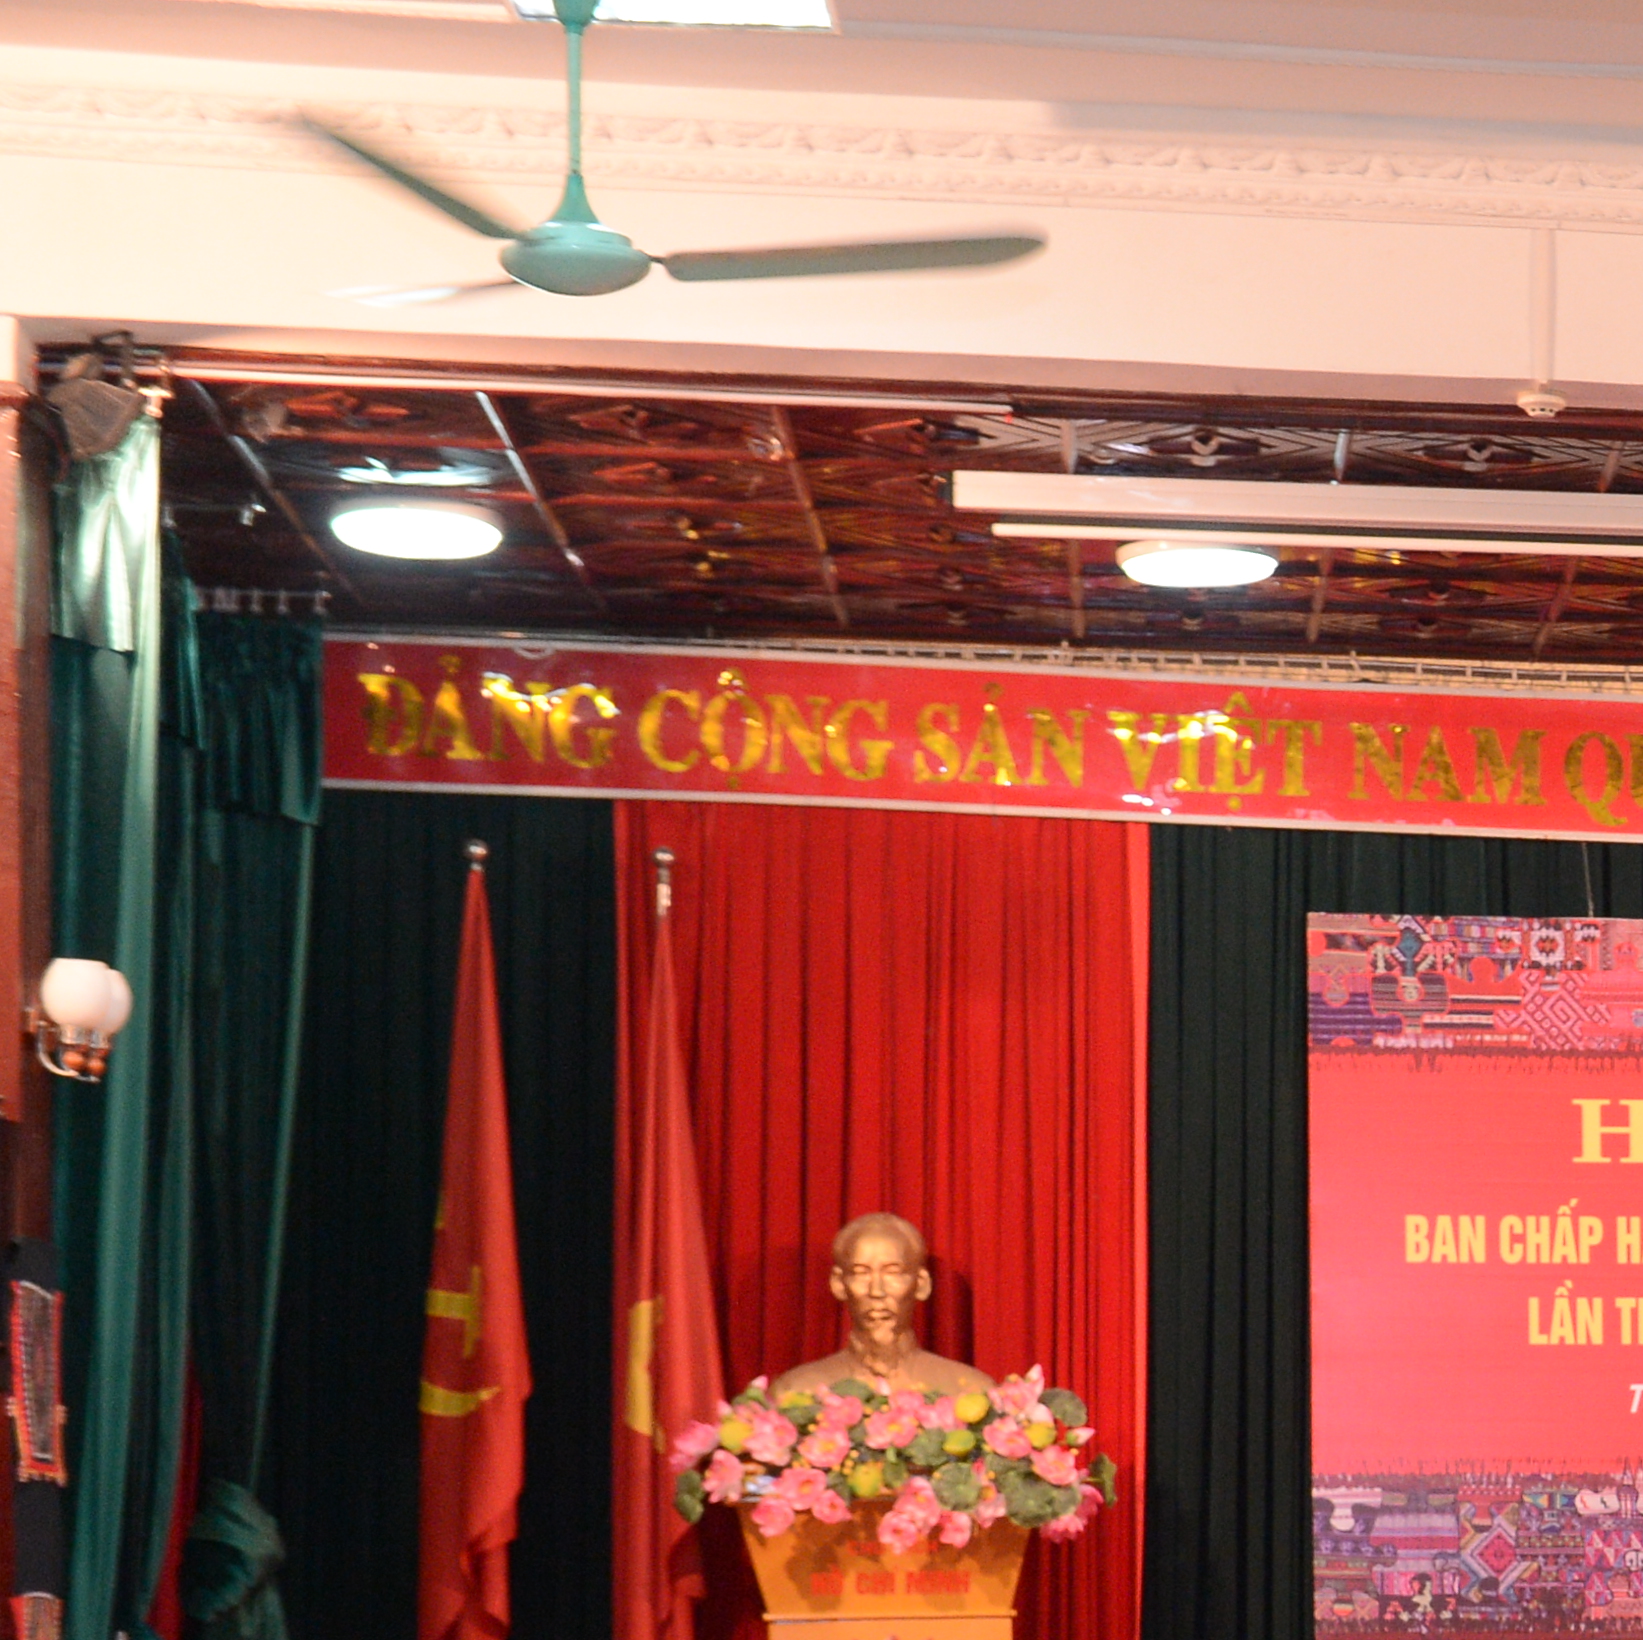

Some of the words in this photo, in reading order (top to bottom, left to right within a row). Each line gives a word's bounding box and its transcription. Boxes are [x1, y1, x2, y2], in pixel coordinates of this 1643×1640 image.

[357, 655, 619, 769] ĐẢNG
[638, 668, 895, 789] CỘNG
[914, 683, 1090, 788] SẢN
[1108, 691, 1322, 811] VIỆT
[1347, 721, 1547, 806] NAM
[1404, 1214, 1486, 1264] BAN
[1500, 1198, 1604, 1264] CHẤP
[1528, 1280, 1604, 1346] LẦN
